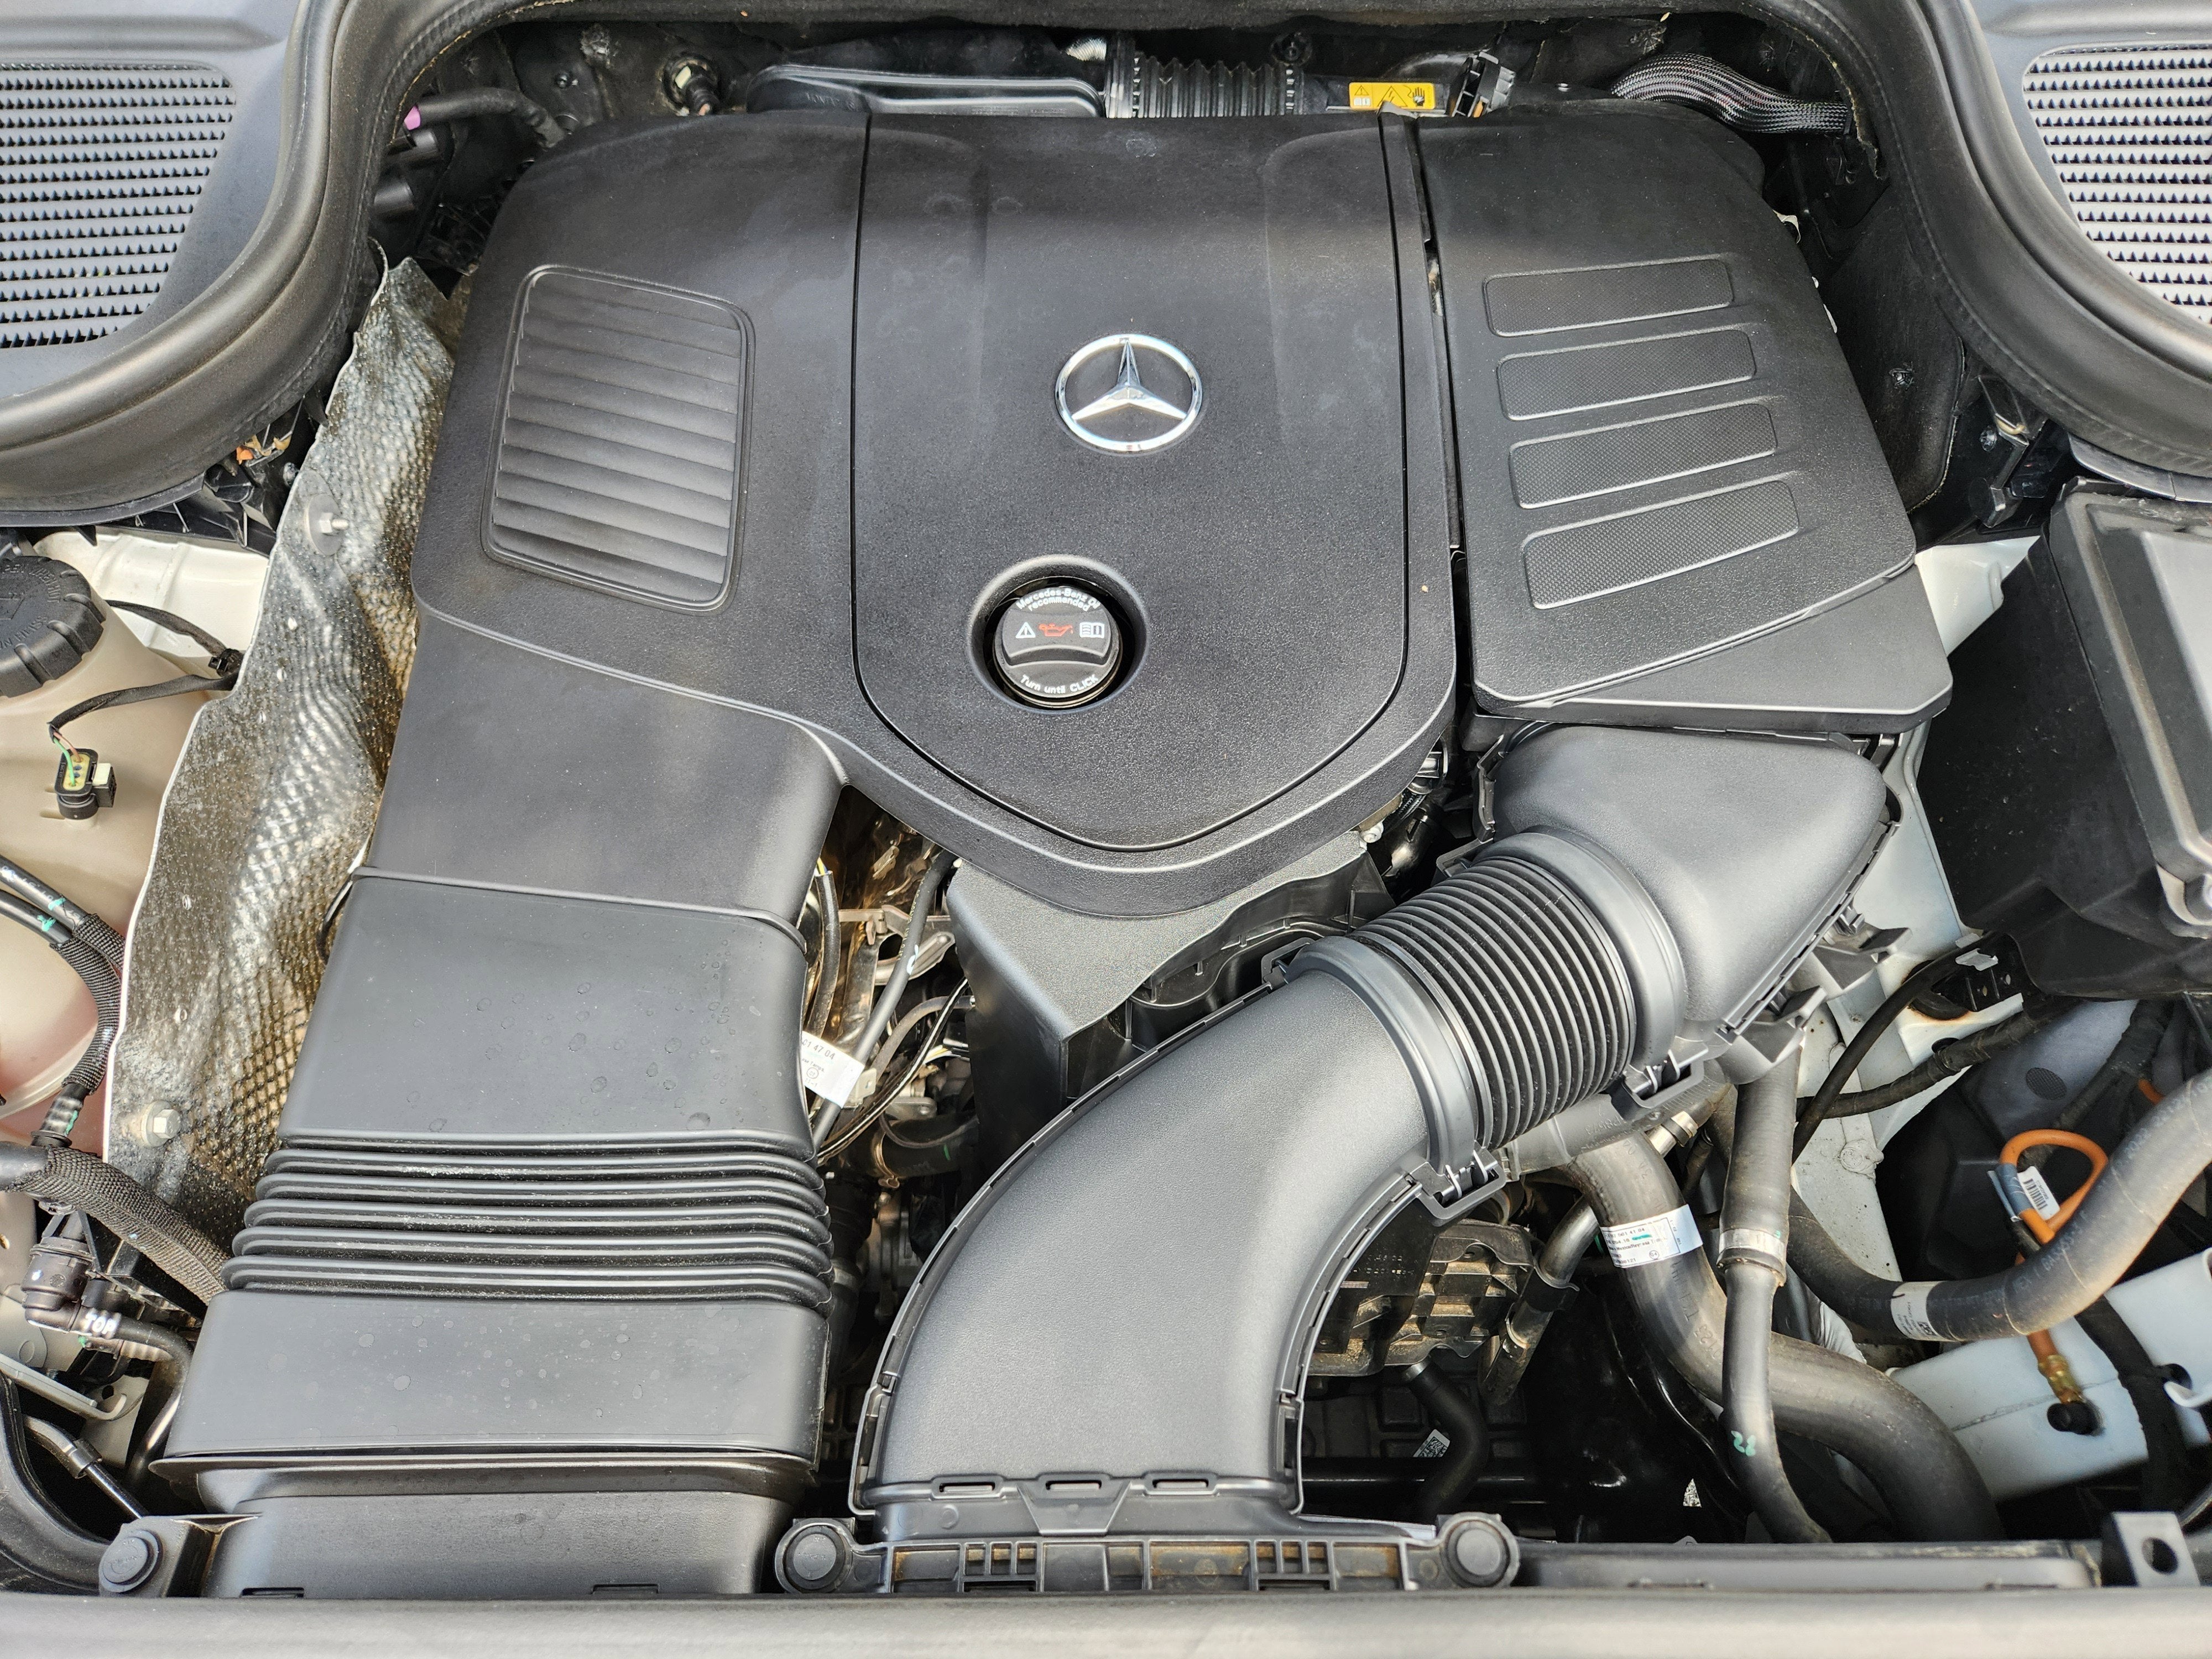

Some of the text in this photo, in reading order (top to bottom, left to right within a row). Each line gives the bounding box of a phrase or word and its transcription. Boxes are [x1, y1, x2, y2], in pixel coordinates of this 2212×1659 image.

[1016, 588, 1102, 610] Mercedes-Benz Oil
[1028, 597, 1089, 612] recommended
[1020, 674, 1099, 694] Turn until CLICK
[813, 1045, 824, 1053] 47
[825, 1050, 836, 1060] 04
[85, 1314, 117, 1334] TOP
